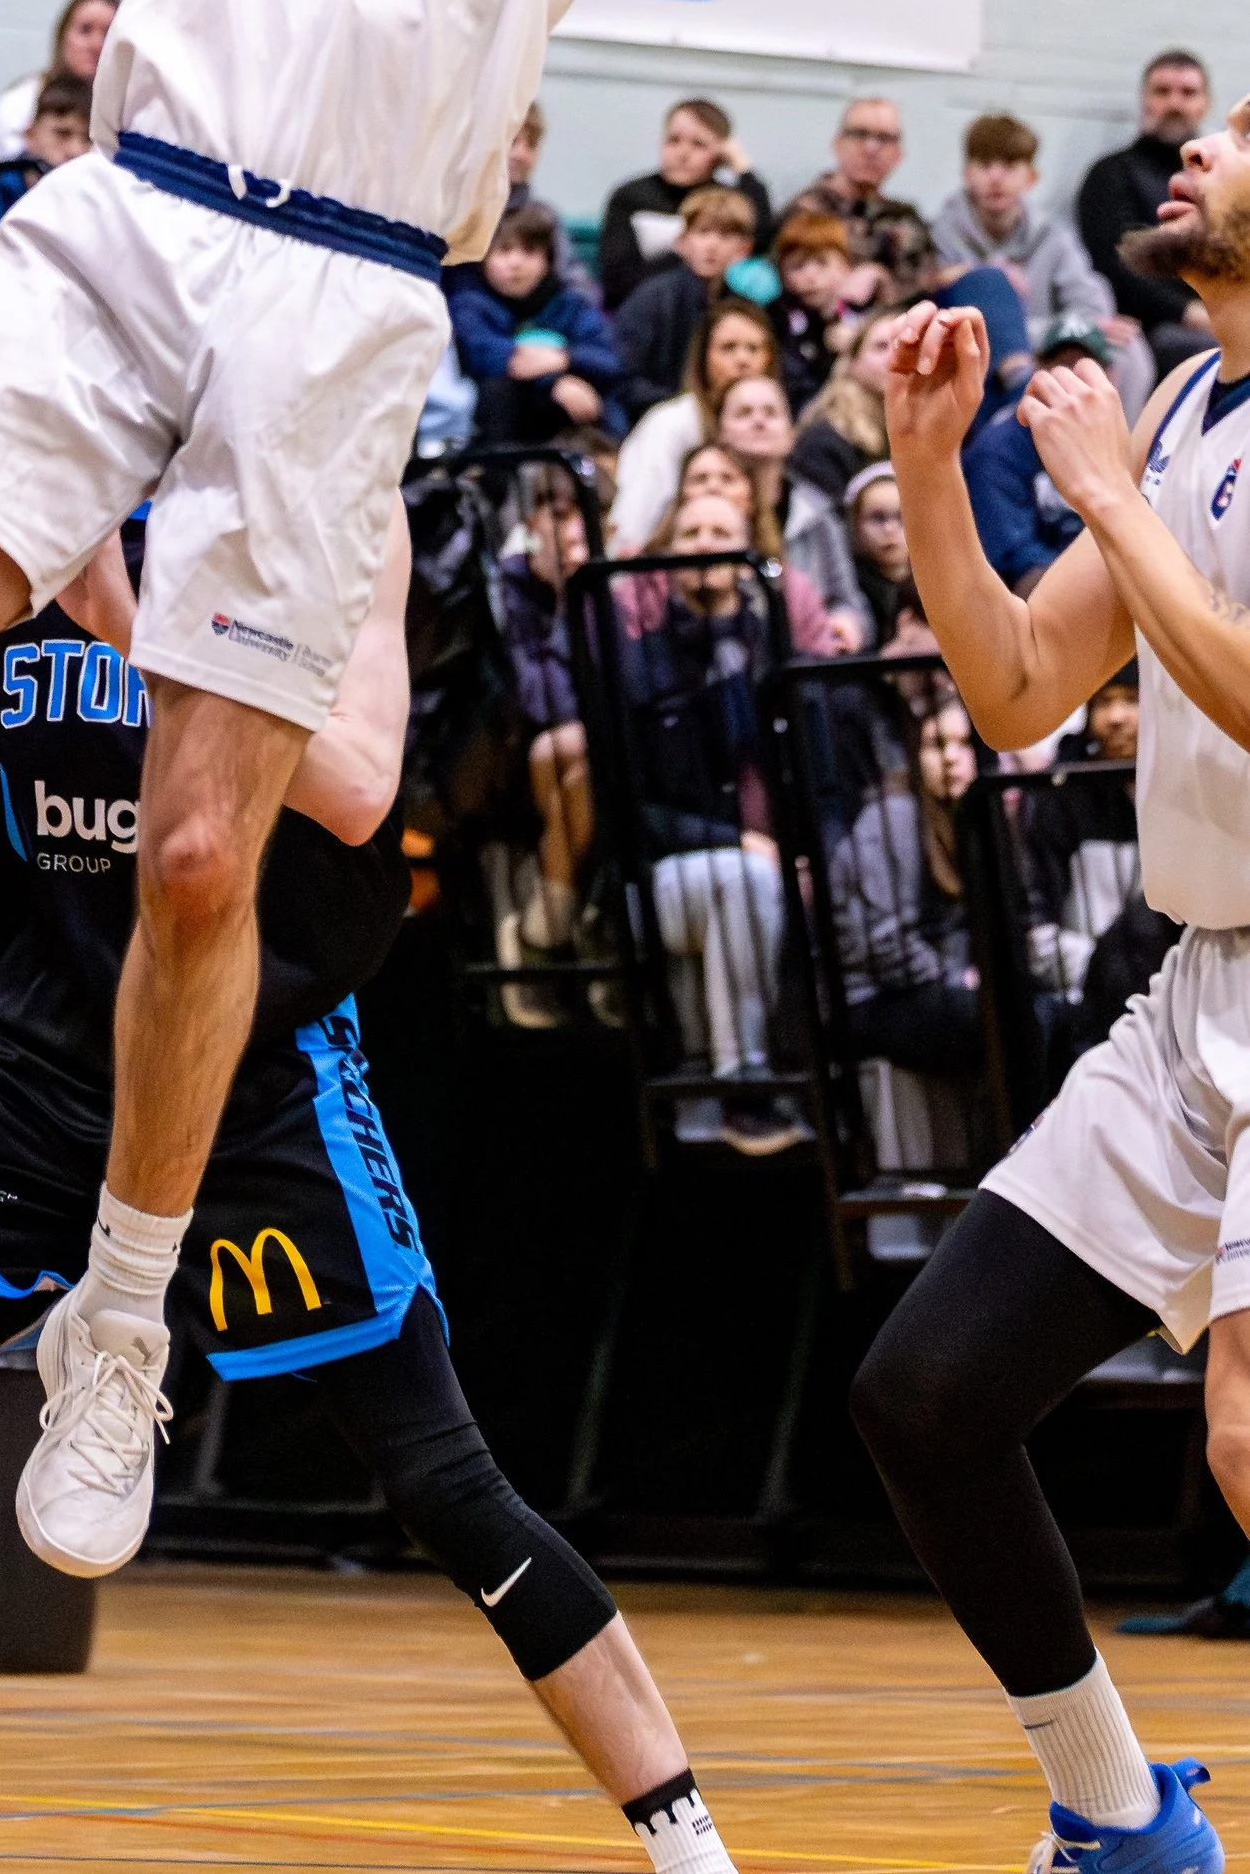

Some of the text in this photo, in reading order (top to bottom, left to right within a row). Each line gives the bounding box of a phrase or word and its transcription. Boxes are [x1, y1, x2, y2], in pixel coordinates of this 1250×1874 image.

[34, 780, 141, 855] bug
[36, 852, 112, 874] GROUP
[321, 1015, 420, 1252] SCHERS
